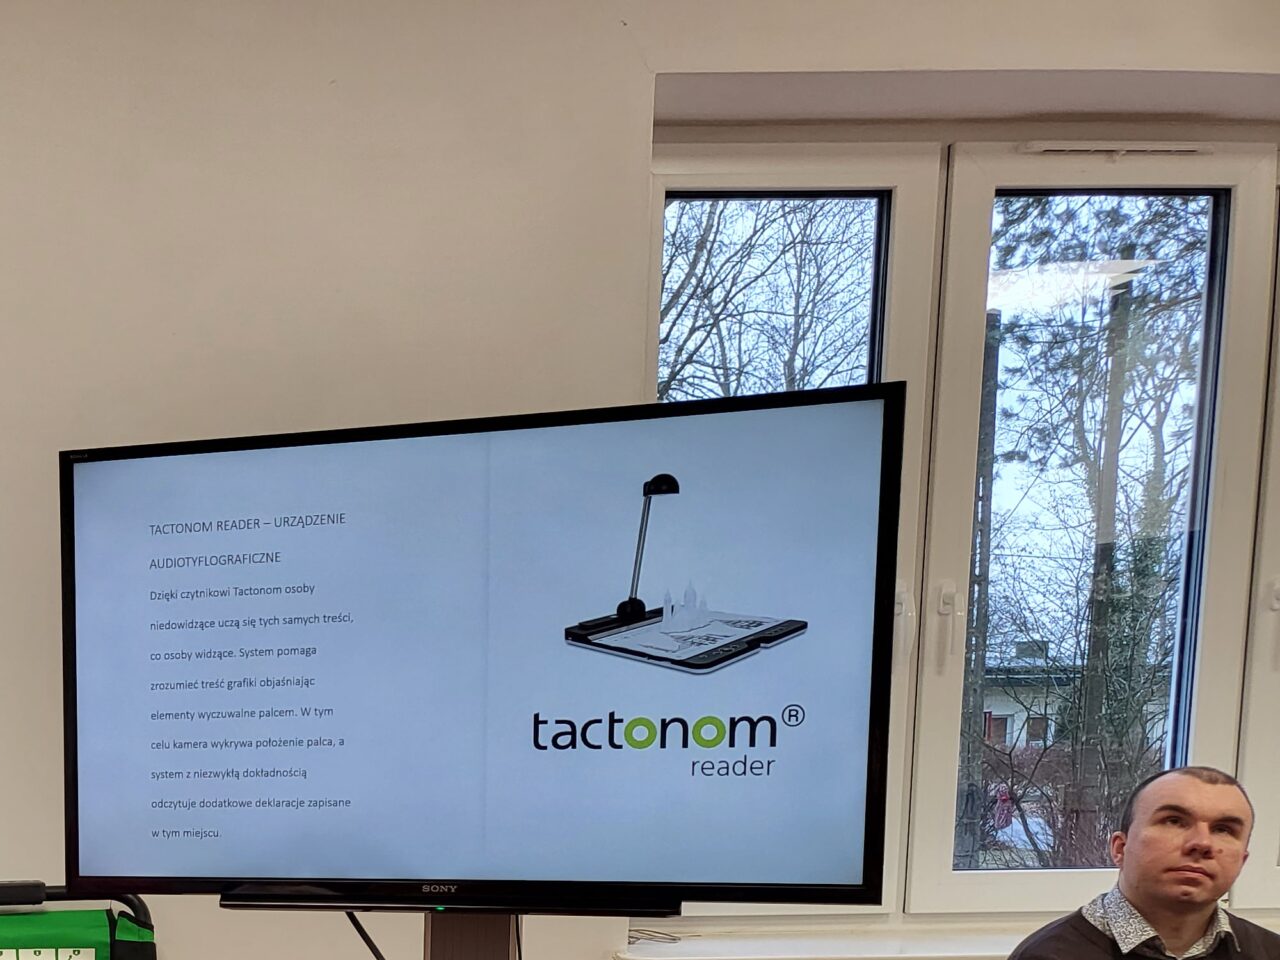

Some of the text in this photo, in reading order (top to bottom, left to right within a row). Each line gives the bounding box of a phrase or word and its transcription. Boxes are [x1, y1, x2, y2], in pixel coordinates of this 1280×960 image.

[149, 521, 213, 536] TACTONOM
[216, 518, 260, 532] READER
[274, 513, 346, 529] URZĄDZENIE
[149, 552, 281, 570] AUDIOTYFLOGRAFICZNE
[150, 583, 315, 602] Dzięki czytnikowi Tactonom osoby
[150, 612, 354, 631] niedowidzące uczą się tych samych treści,
[150, 647, 317, 662] co osoby widzące. System pomaga
[150, 676, 316, 691] zrozumieć treść grafiki objaśniając
[151, 706, 334, 722] elementy wyczuwalne palcem. W tym
[151, 736, 345, 751] celu kamera wykrywa położenie palca, a
[691, 755, 776, 777] reader
[151, 767, 307, 781] system z niezwykłą dokładnością
[151, 797, 351, 812] odczytuje dodatkowe deklaracje zapisane
[151, 827, 222, 840] w tym miejscu.
[422, 884, 457, 892] SONY
